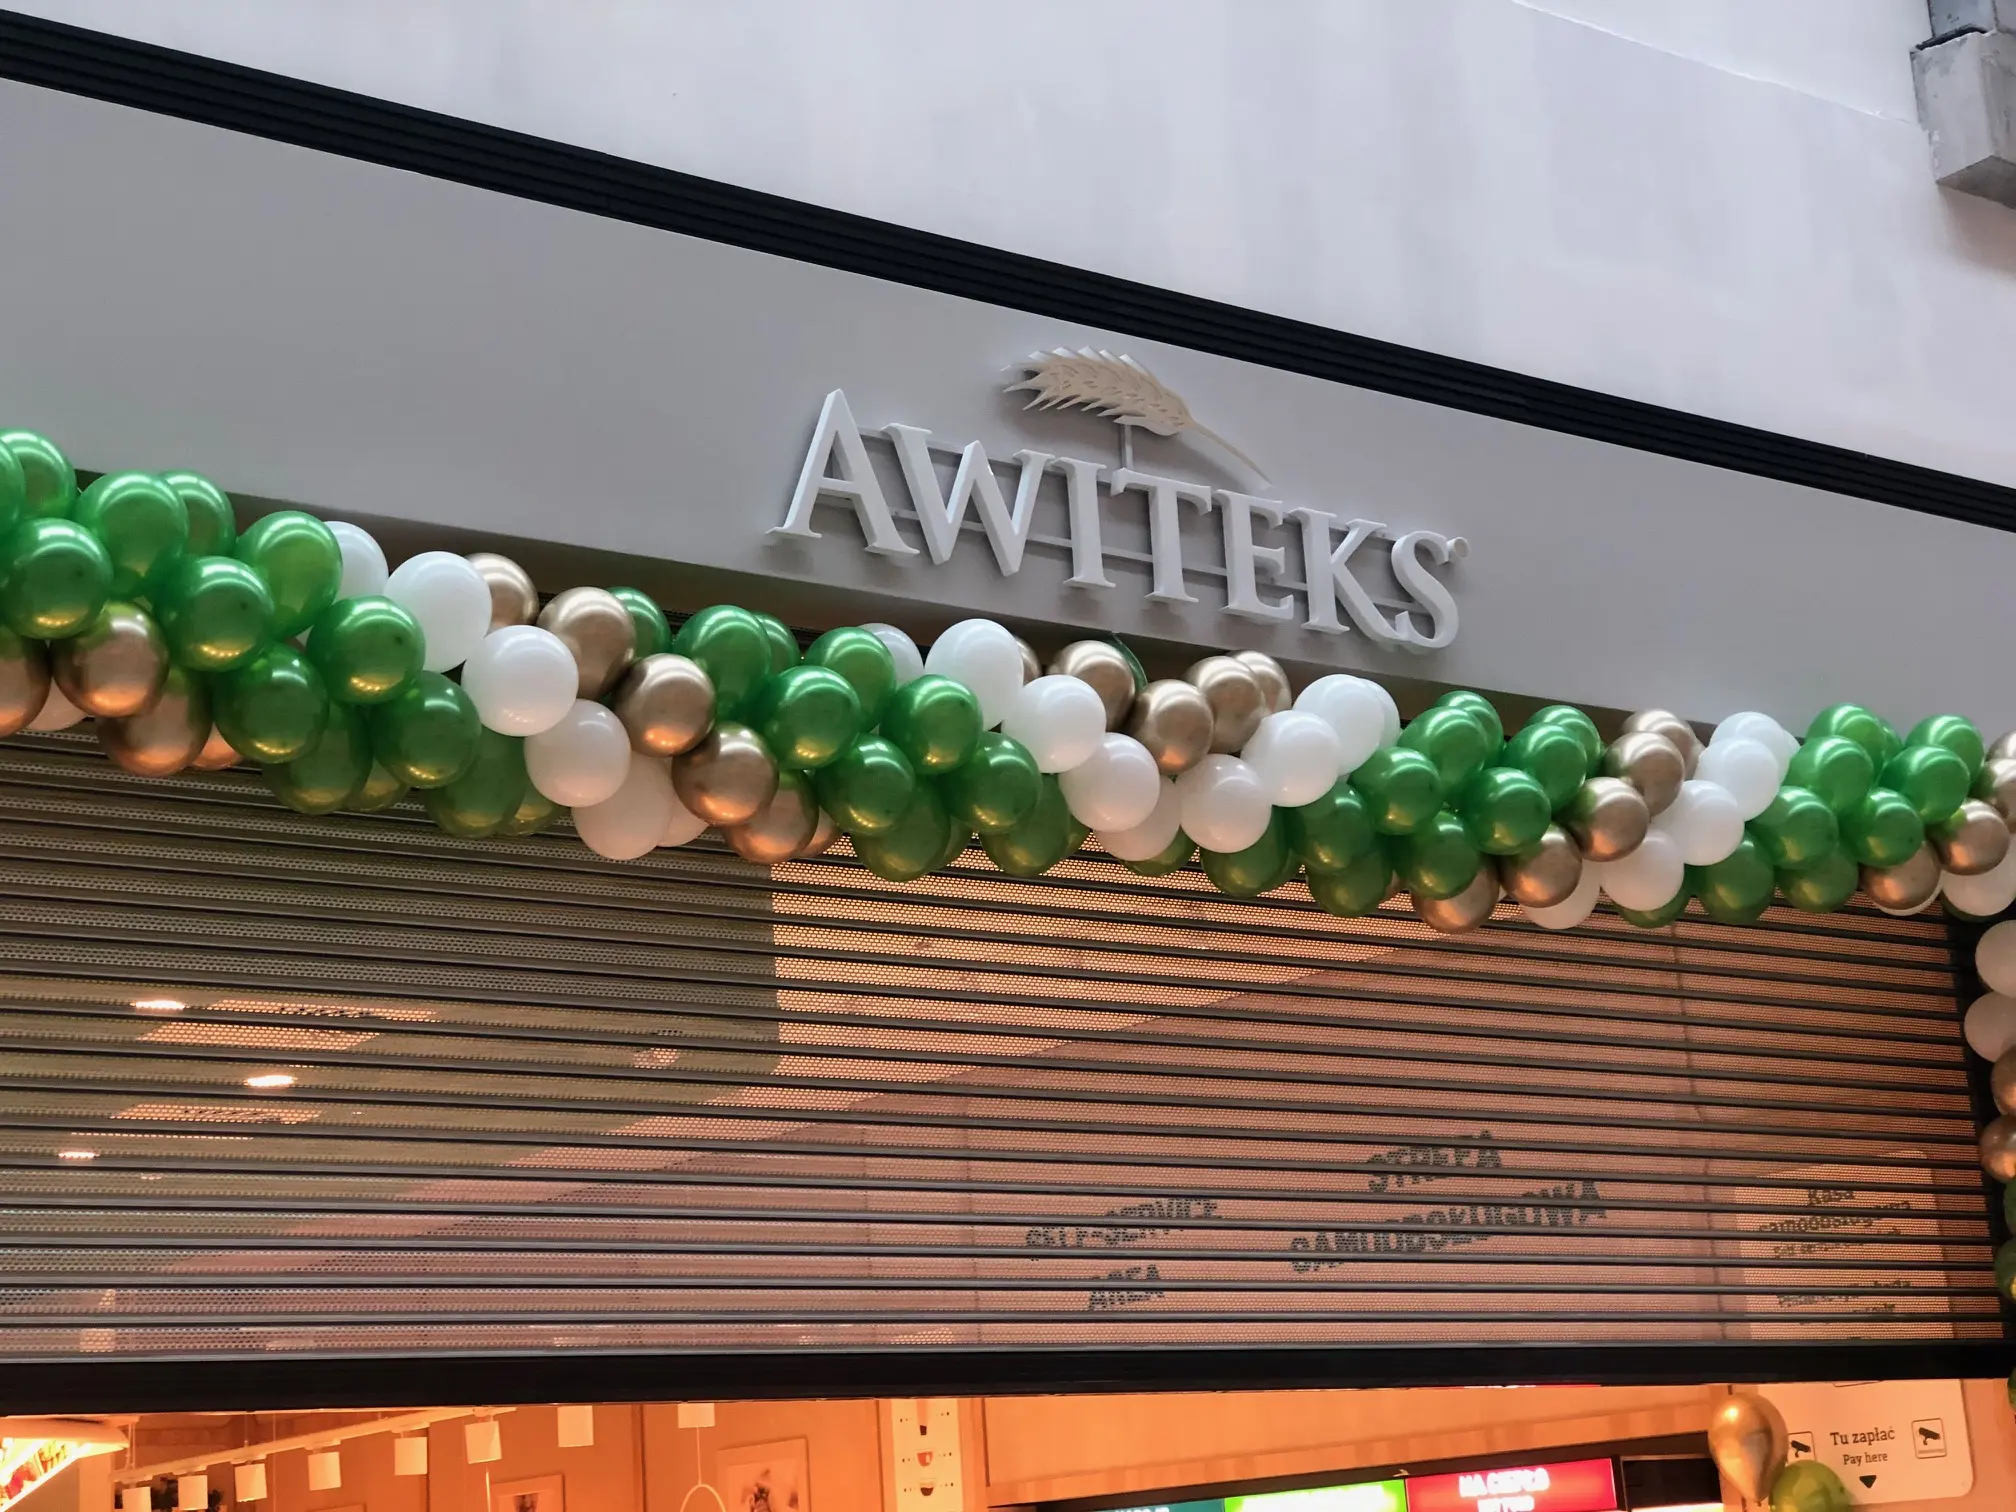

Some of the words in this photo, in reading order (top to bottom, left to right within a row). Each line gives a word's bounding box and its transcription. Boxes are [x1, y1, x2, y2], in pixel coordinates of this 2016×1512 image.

[766, 388, 1460, 648] AWITEKS
[1829, 1432, 1850, 1446] Tu
[1852, 1426, 1895, 1446] zapłać
[1843, 1454, 1862, 1466] Pay
[1864, 1452, 1888, 1463] here
